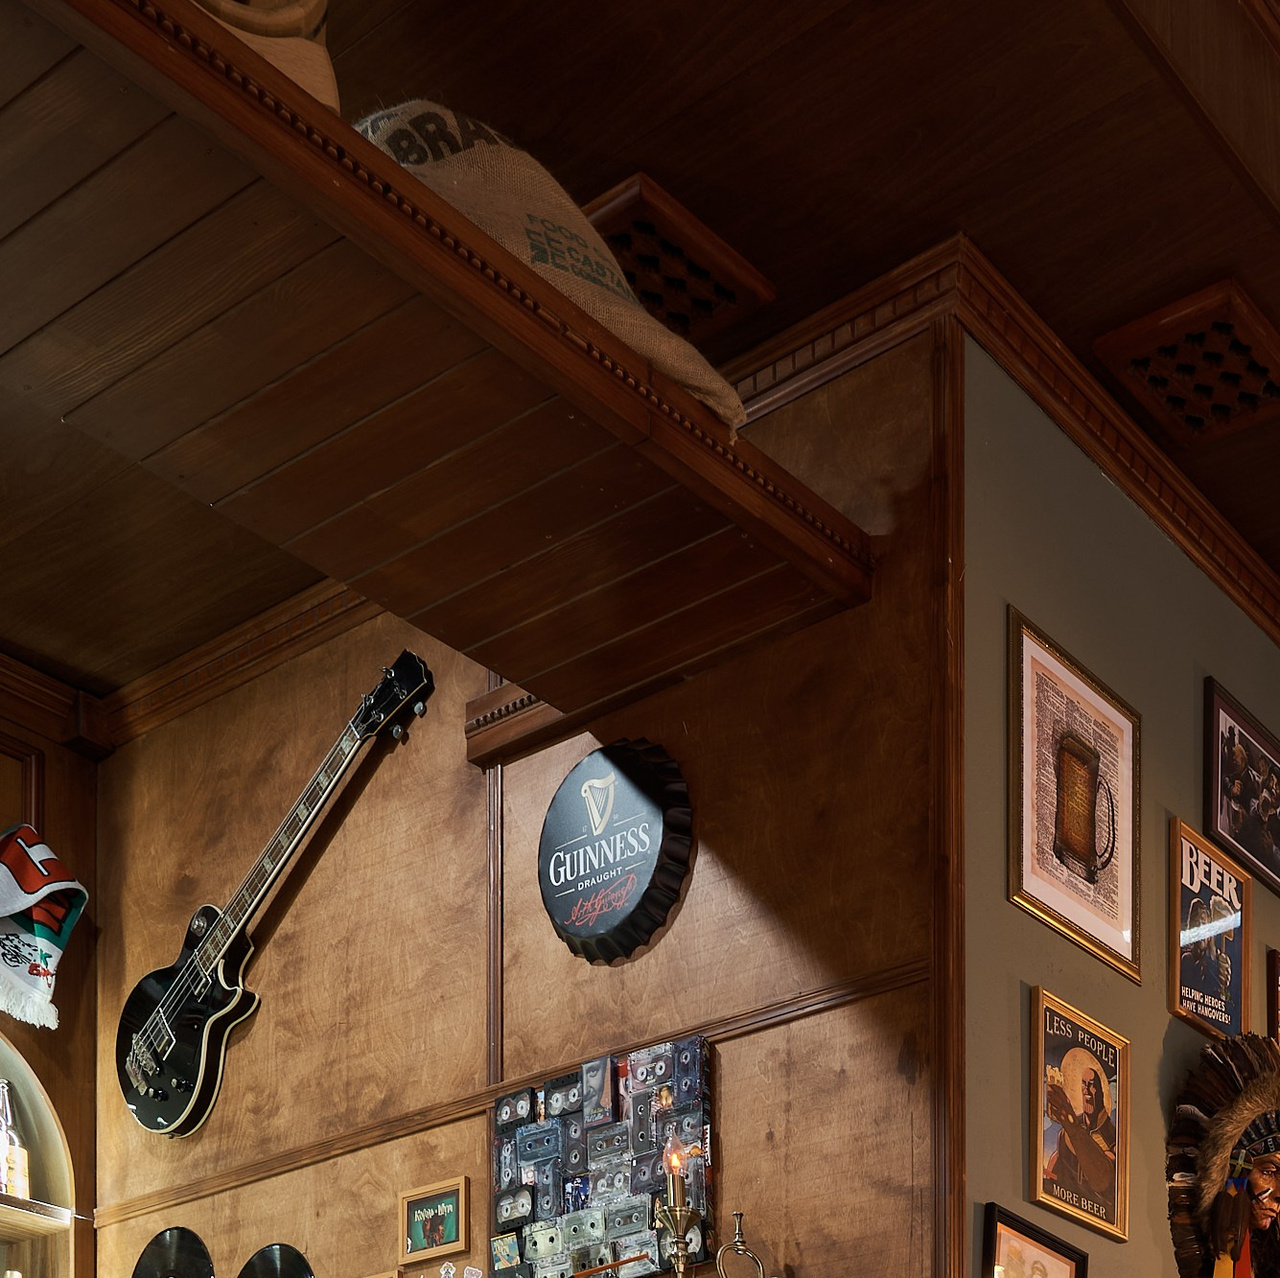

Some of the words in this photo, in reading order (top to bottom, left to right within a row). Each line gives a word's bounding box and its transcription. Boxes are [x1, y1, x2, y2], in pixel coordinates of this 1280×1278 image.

[550, 823, 650, 887] GUINNESS
[577, 866, 623, 891] DRAUGHT
[1181, 837, 1242, 910] BEER
[1181, 985, 1204, 1003] HELPING
[1204, 994, 1226, 1012] HEROES
[1182, 999, 1196, 1013] HAVE
[1197, 1003, 1231, 1025] HANGOVERS!
[1046, 1011, 1073, 1038] LESS
[1078, 1030, 1115, 1068] PEOPLE
[1053, 1183, 1079, 1206] MORE
[1081, 1197, 1106, 1219] BEER
